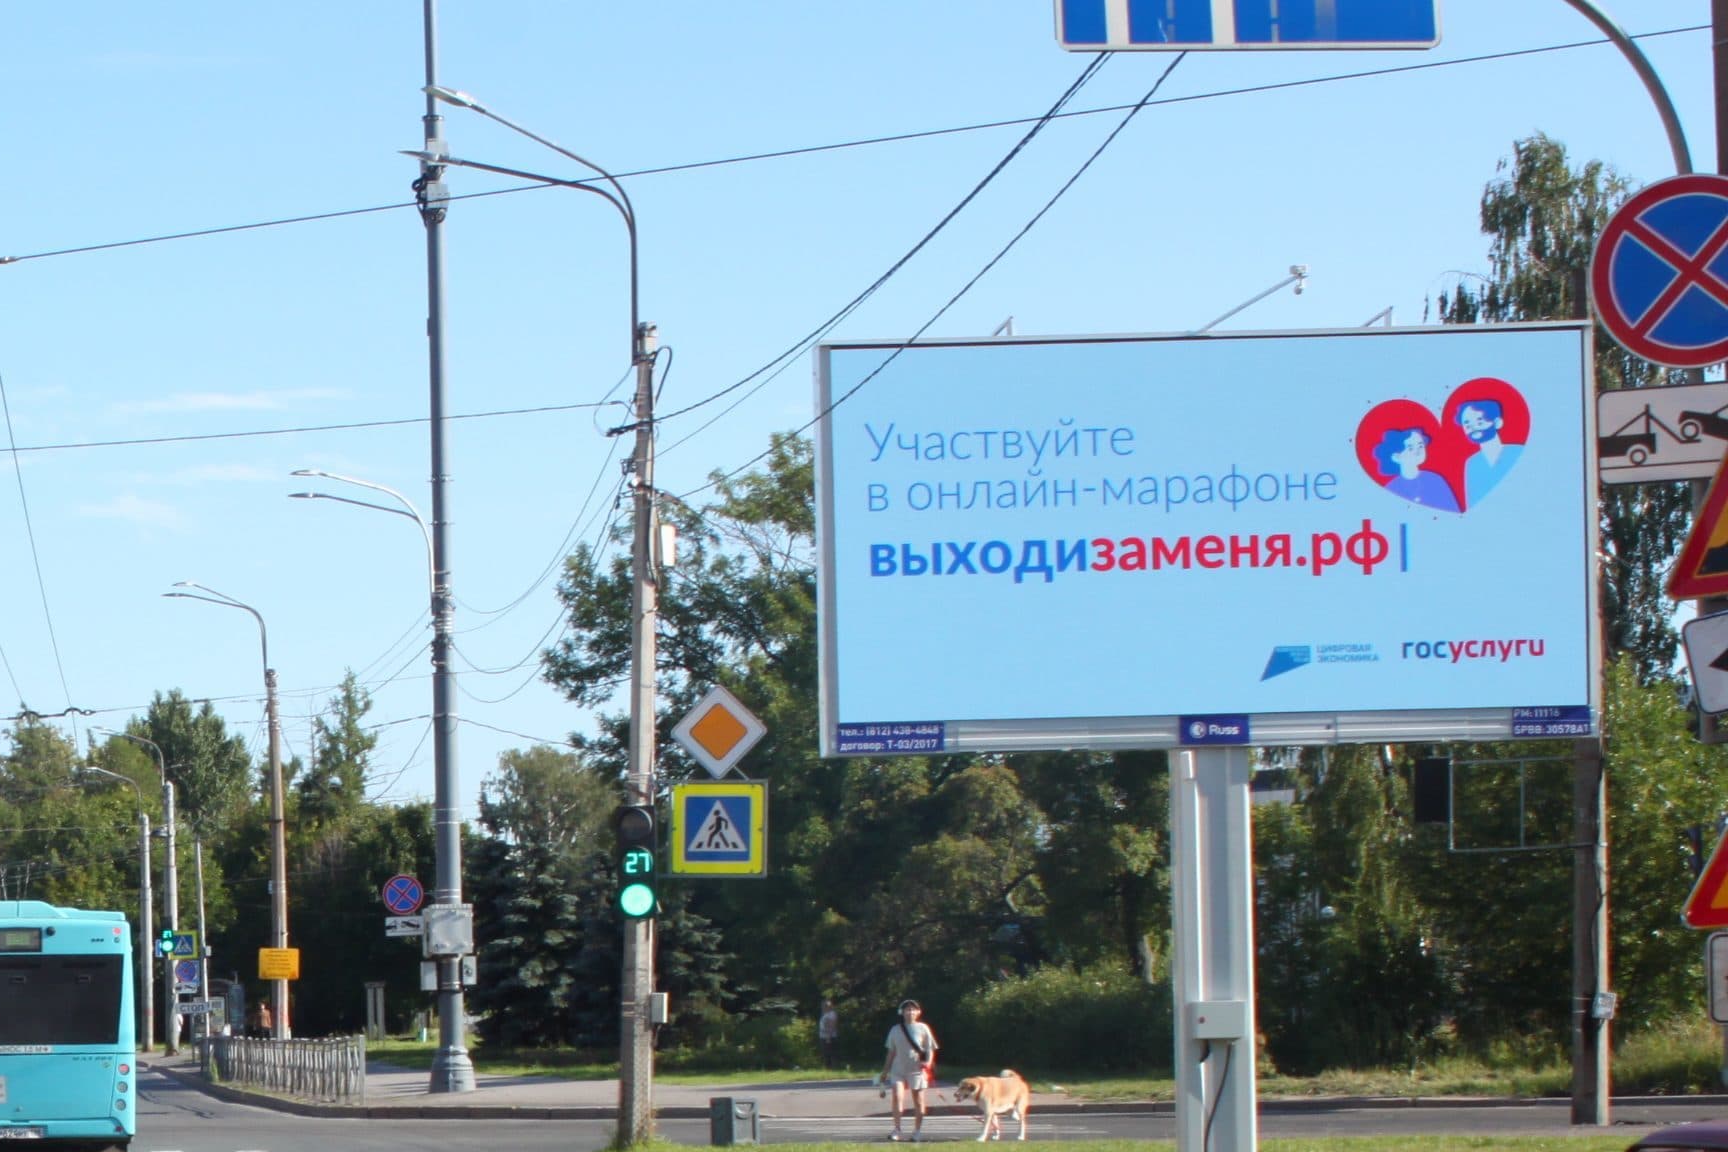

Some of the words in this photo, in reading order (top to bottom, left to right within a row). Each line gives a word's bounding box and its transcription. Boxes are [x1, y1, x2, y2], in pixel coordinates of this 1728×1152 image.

[864, 418, 1135, 464] Участвуйте
[867, 484, 889, 512] в
[905, 464, 1339, 512] онлайн-марафоне
[869, 518, 1390, 583] выходизаменя.рф
[1402, 639, 1544, 663] госуслуги
[1208, 724, 1239, 736] Russ
[624, 852, 652, 874] 27
